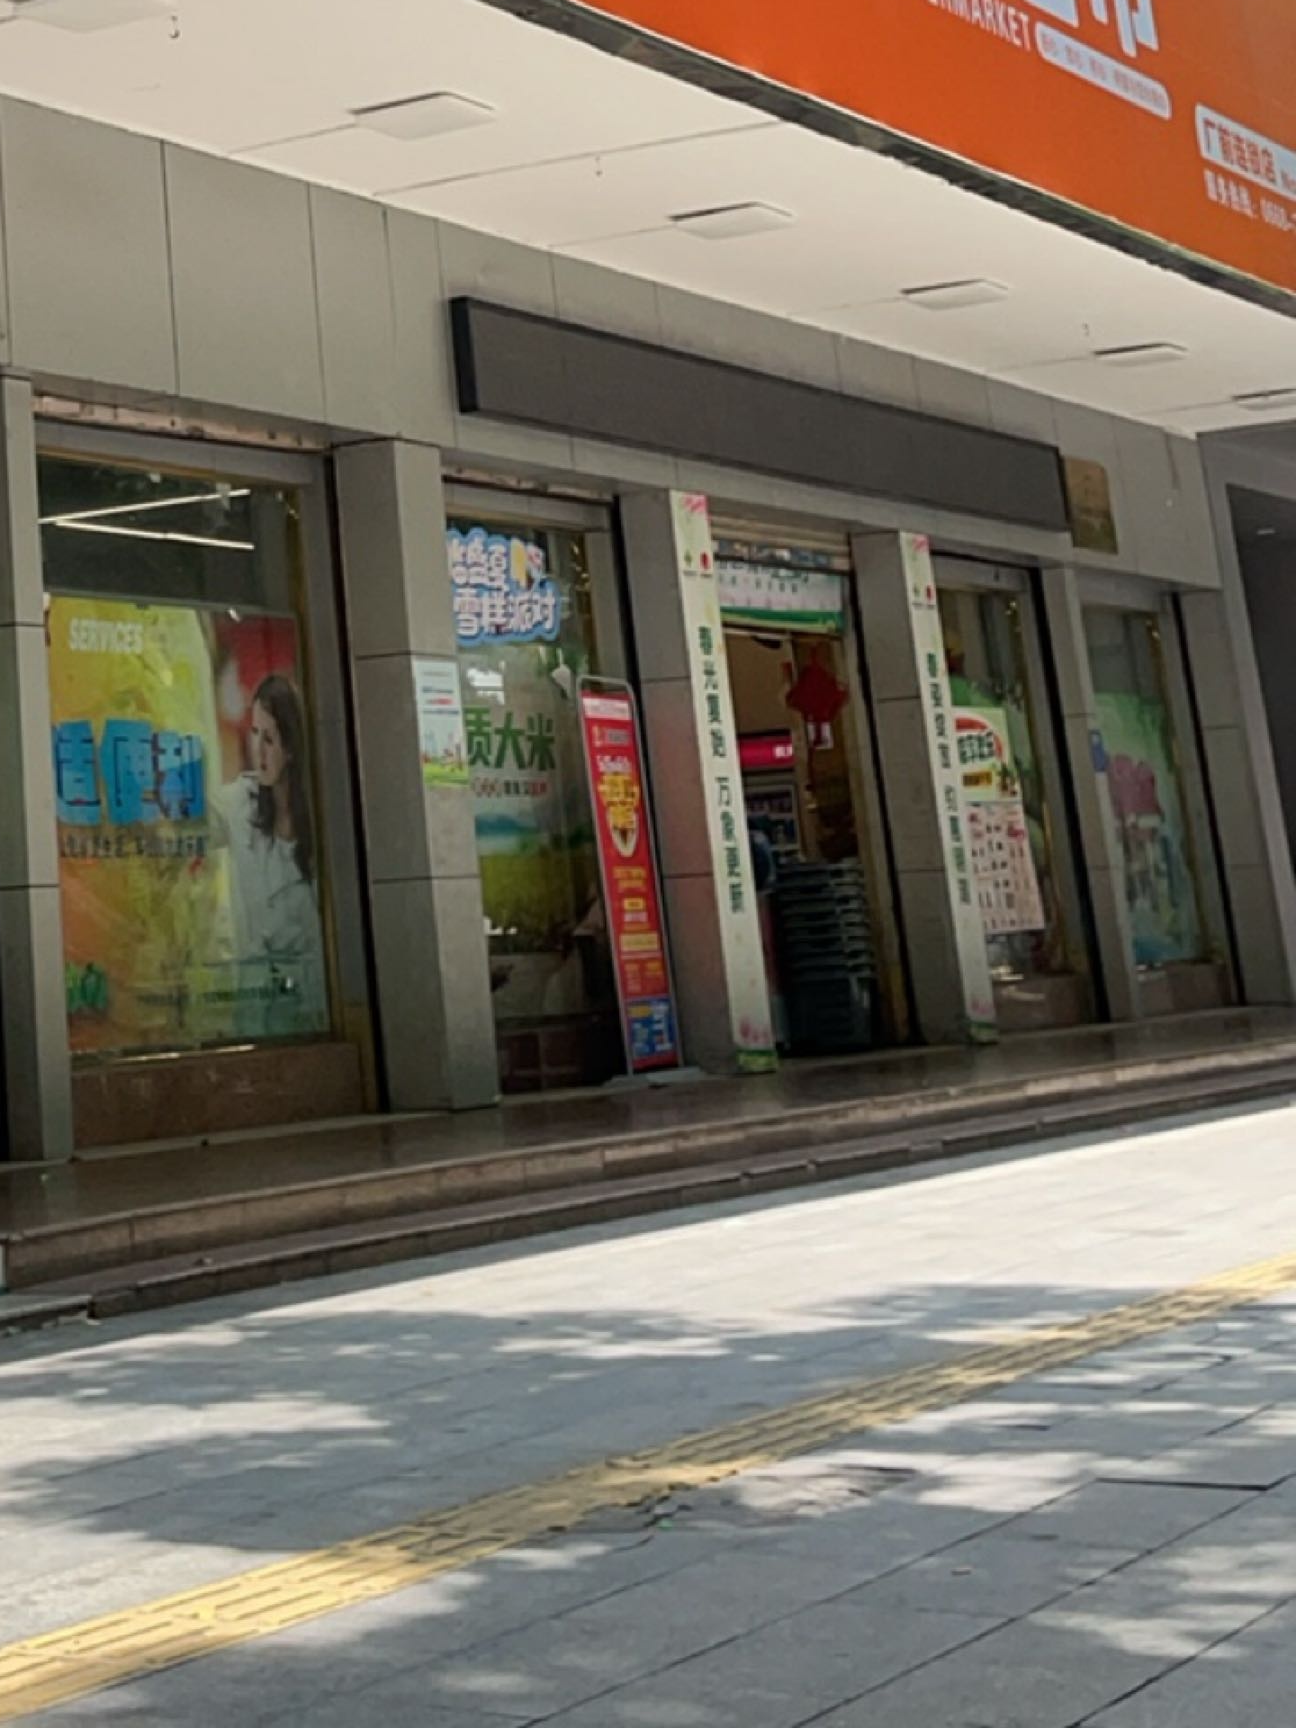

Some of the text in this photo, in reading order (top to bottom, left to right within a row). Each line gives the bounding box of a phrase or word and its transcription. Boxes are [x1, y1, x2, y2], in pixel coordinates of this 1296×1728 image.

[452, 587, 556, 635] 雪糕派对
[68, 618, 144, 655] SERVICES
